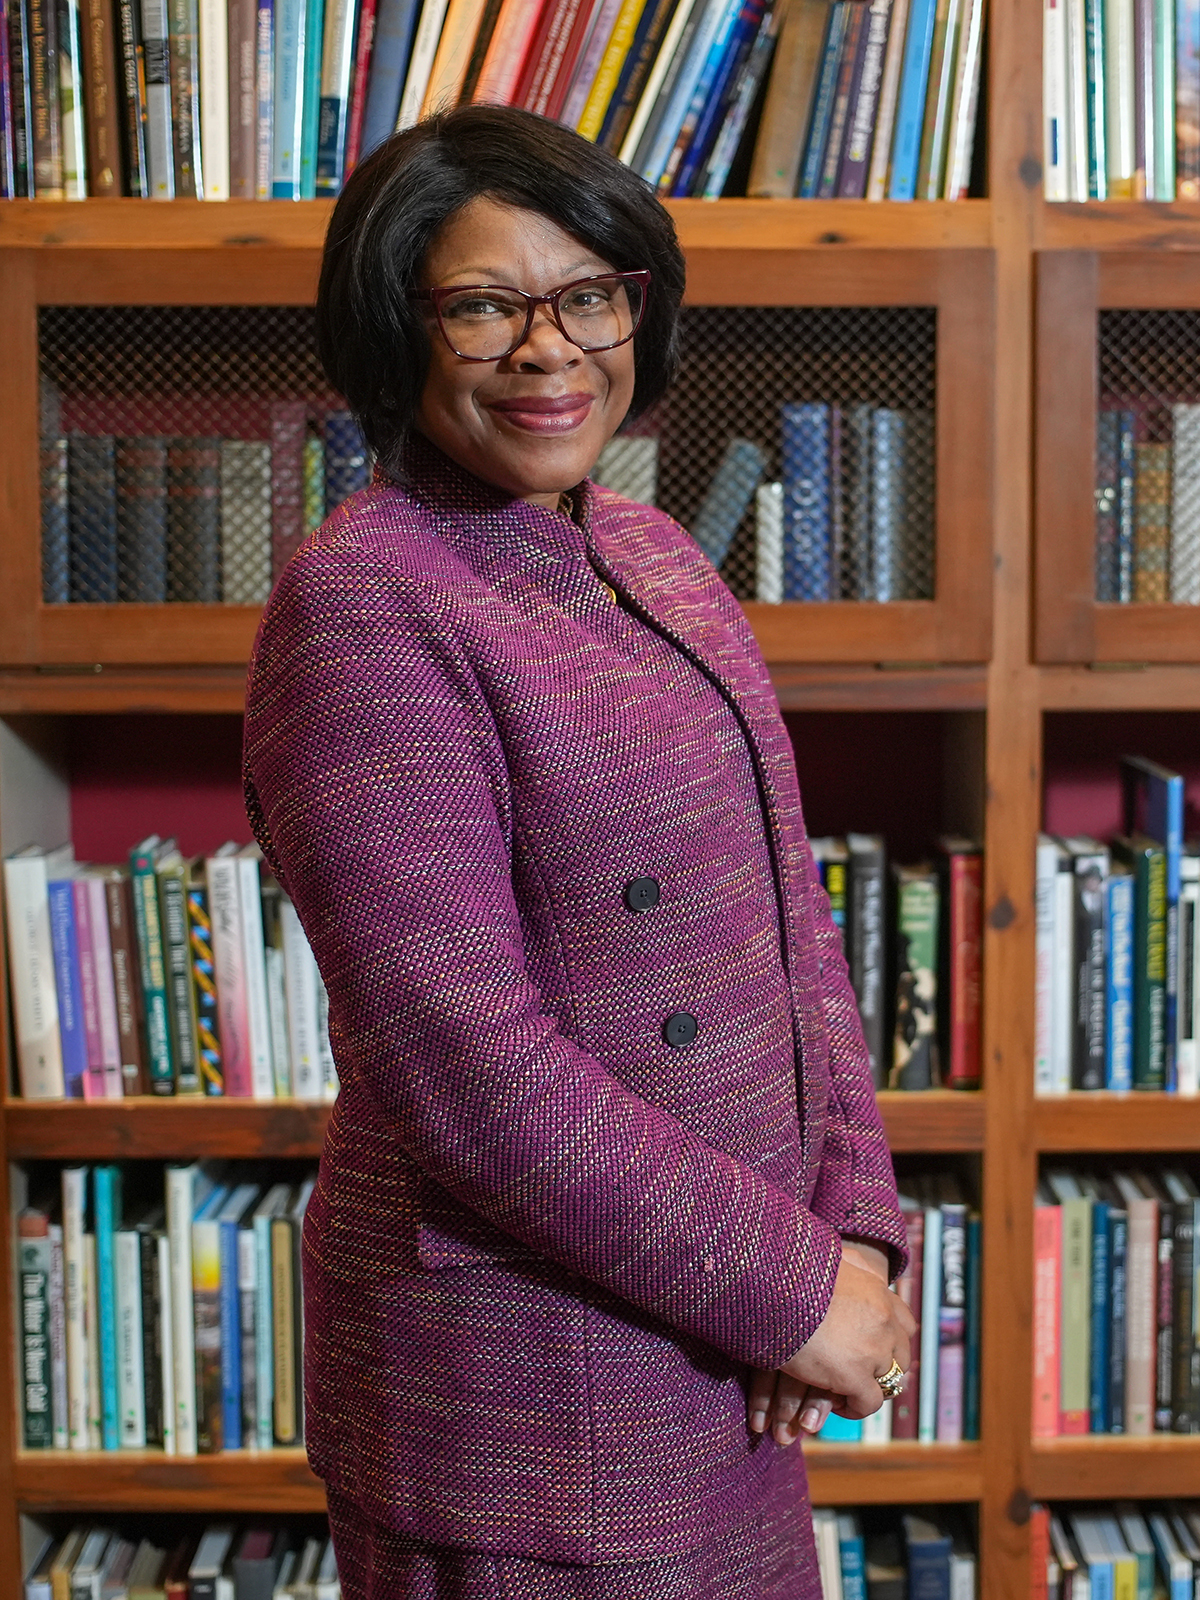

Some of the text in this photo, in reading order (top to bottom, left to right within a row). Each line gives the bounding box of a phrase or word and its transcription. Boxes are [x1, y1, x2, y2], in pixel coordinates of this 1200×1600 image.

[1148, 853, 1166, 920] CHARLES
[1091, 928, 1104, 966] MAN
[23, 1273, 45, 1297] The
